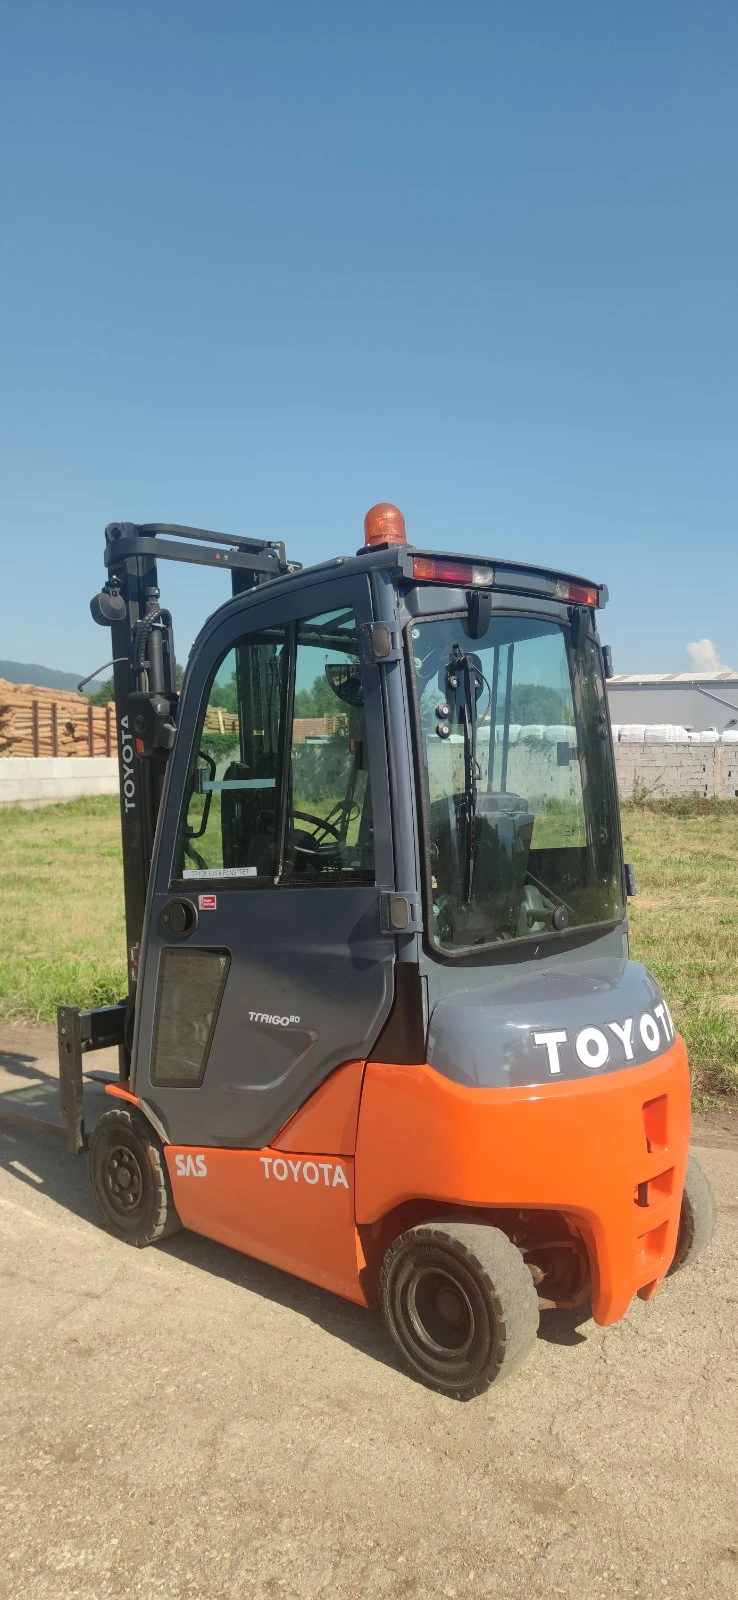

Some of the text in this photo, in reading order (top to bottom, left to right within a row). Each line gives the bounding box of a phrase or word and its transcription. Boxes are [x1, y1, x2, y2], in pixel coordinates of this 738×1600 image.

[120, 715, 136, 814] TOYOTA
[175, 1154, 207, 1177] SAS
[260, 1157, 349, 1188] TOYOTA
